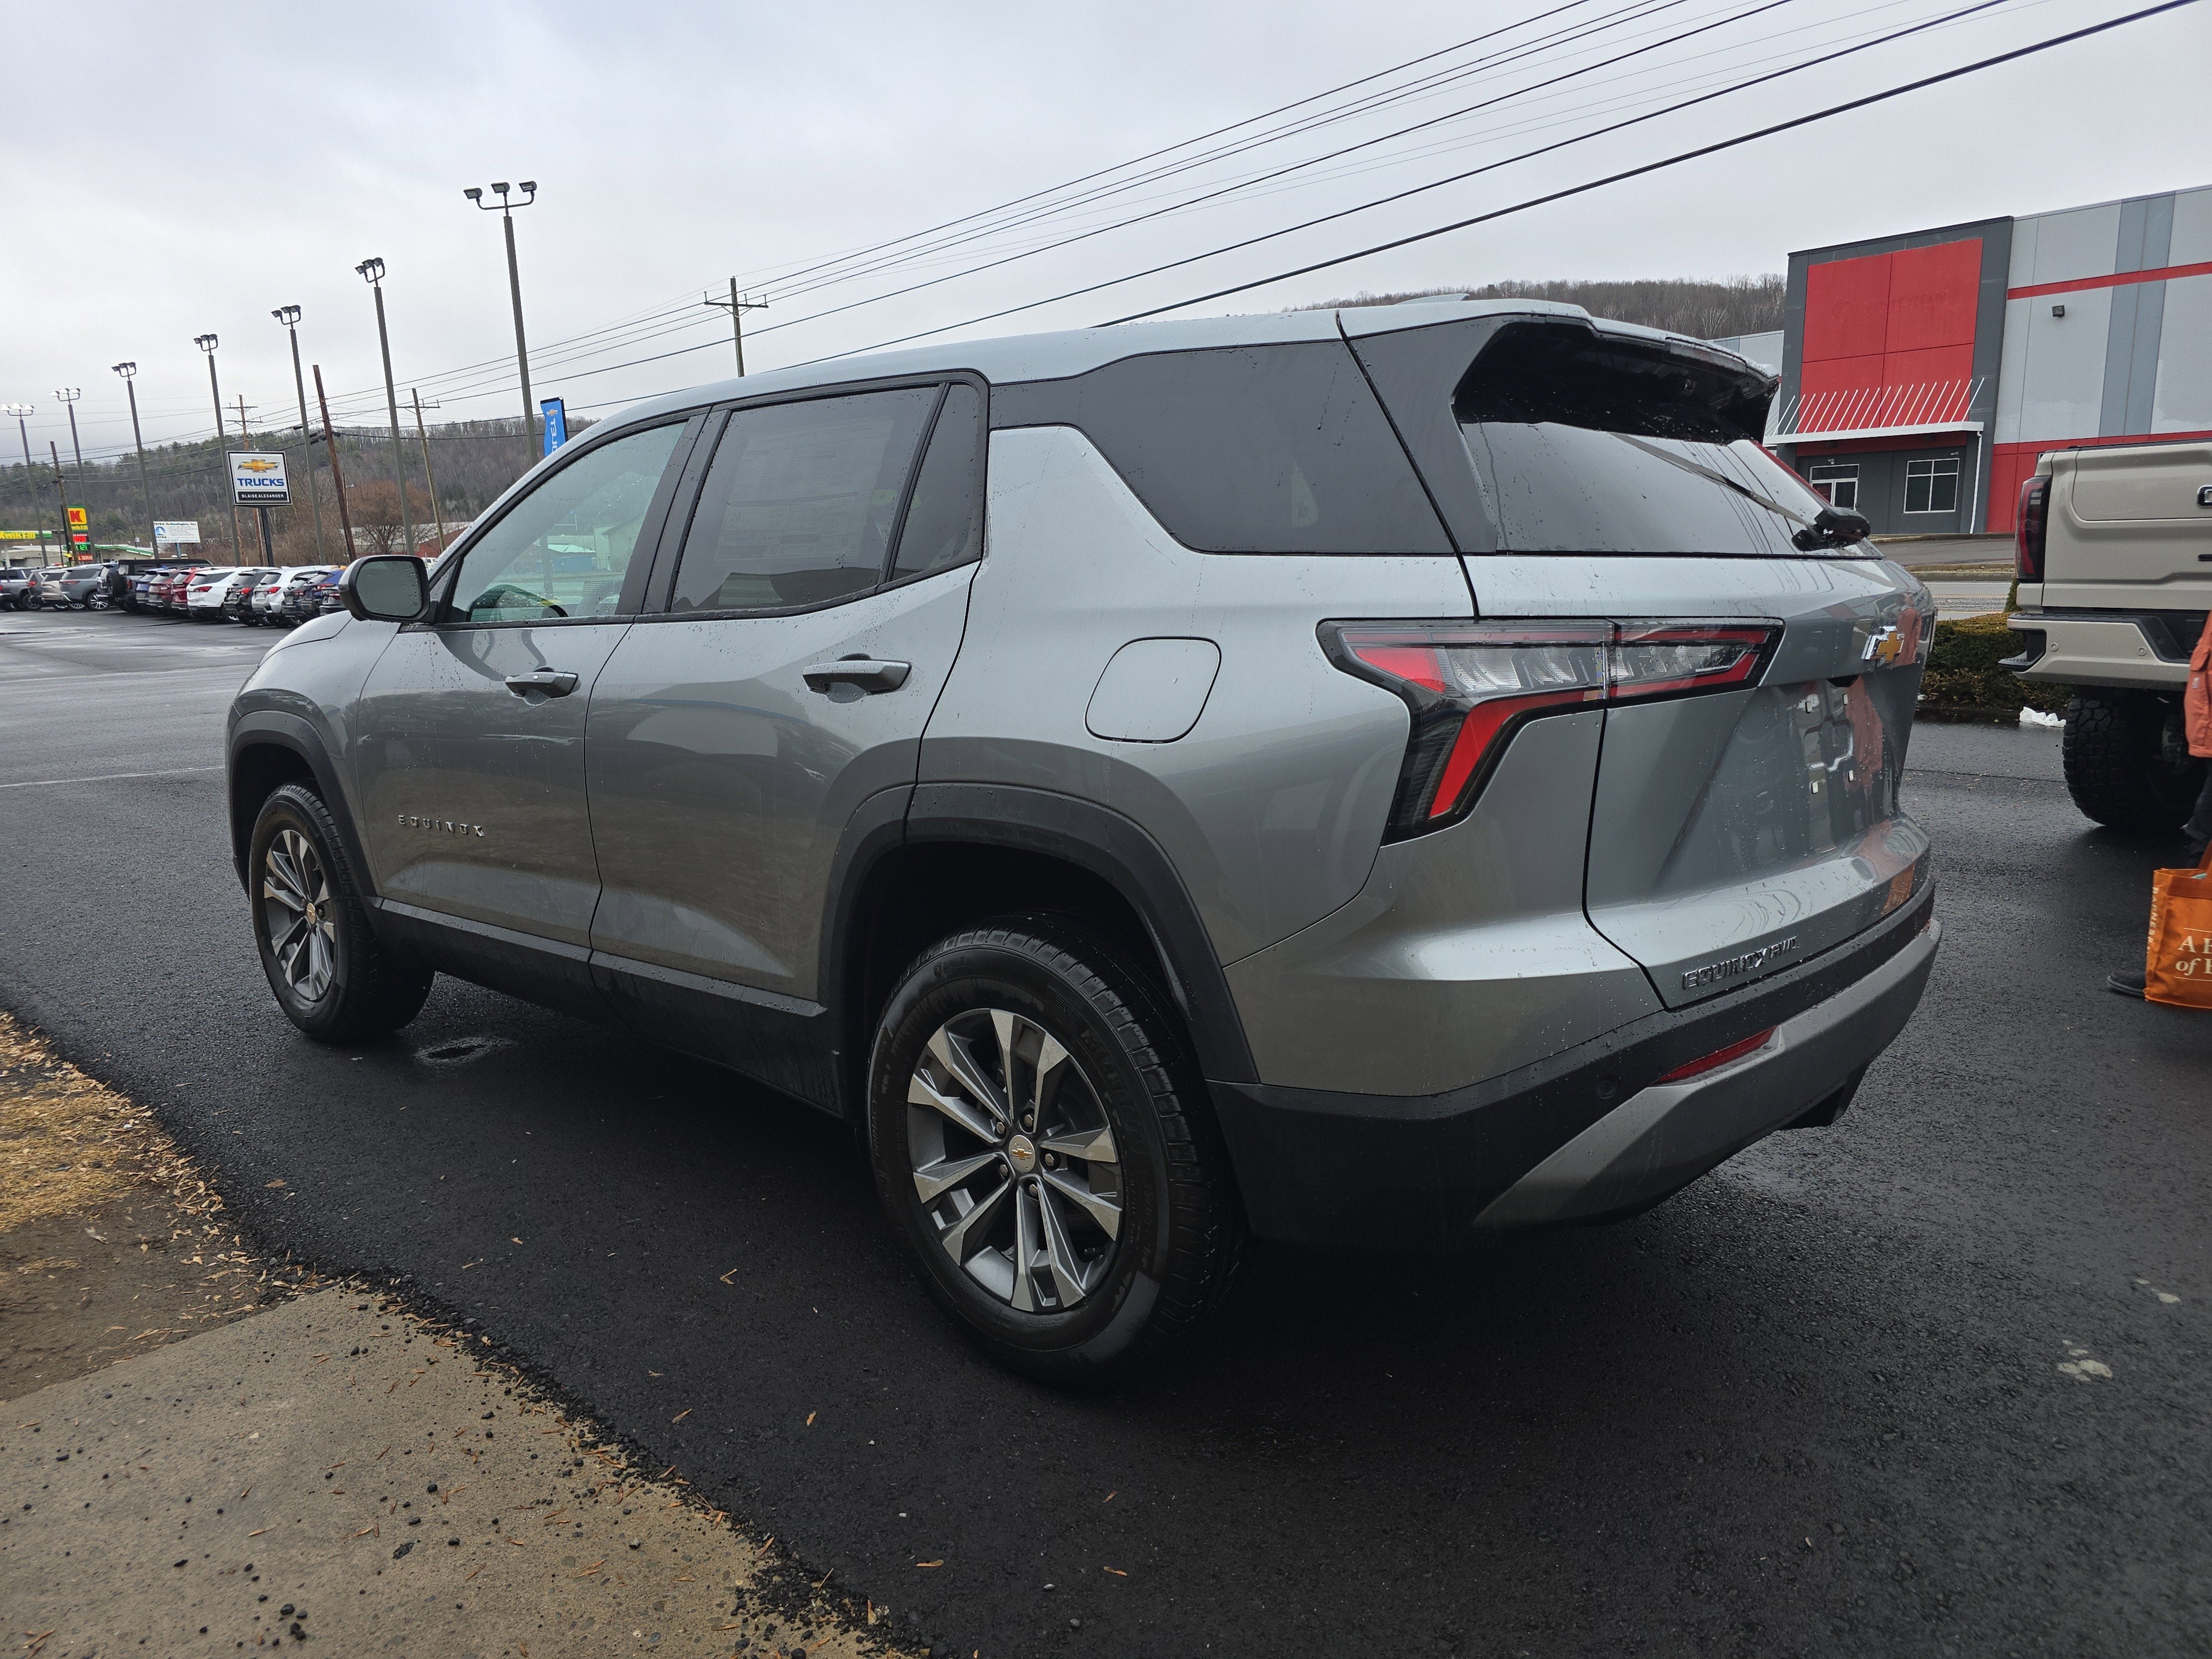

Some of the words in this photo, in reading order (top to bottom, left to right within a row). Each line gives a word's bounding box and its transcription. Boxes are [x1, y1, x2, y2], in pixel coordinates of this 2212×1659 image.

[237, 478, 285, 486] TRUCKS
[69, 511, 83, 523] K
[397, 814, 485, 838] EQUINOX
[2177, 935, 2197, 953] A
[1682, 947, 1767, 991] EQUINOX
[2176, 958, 2201, 976] of
